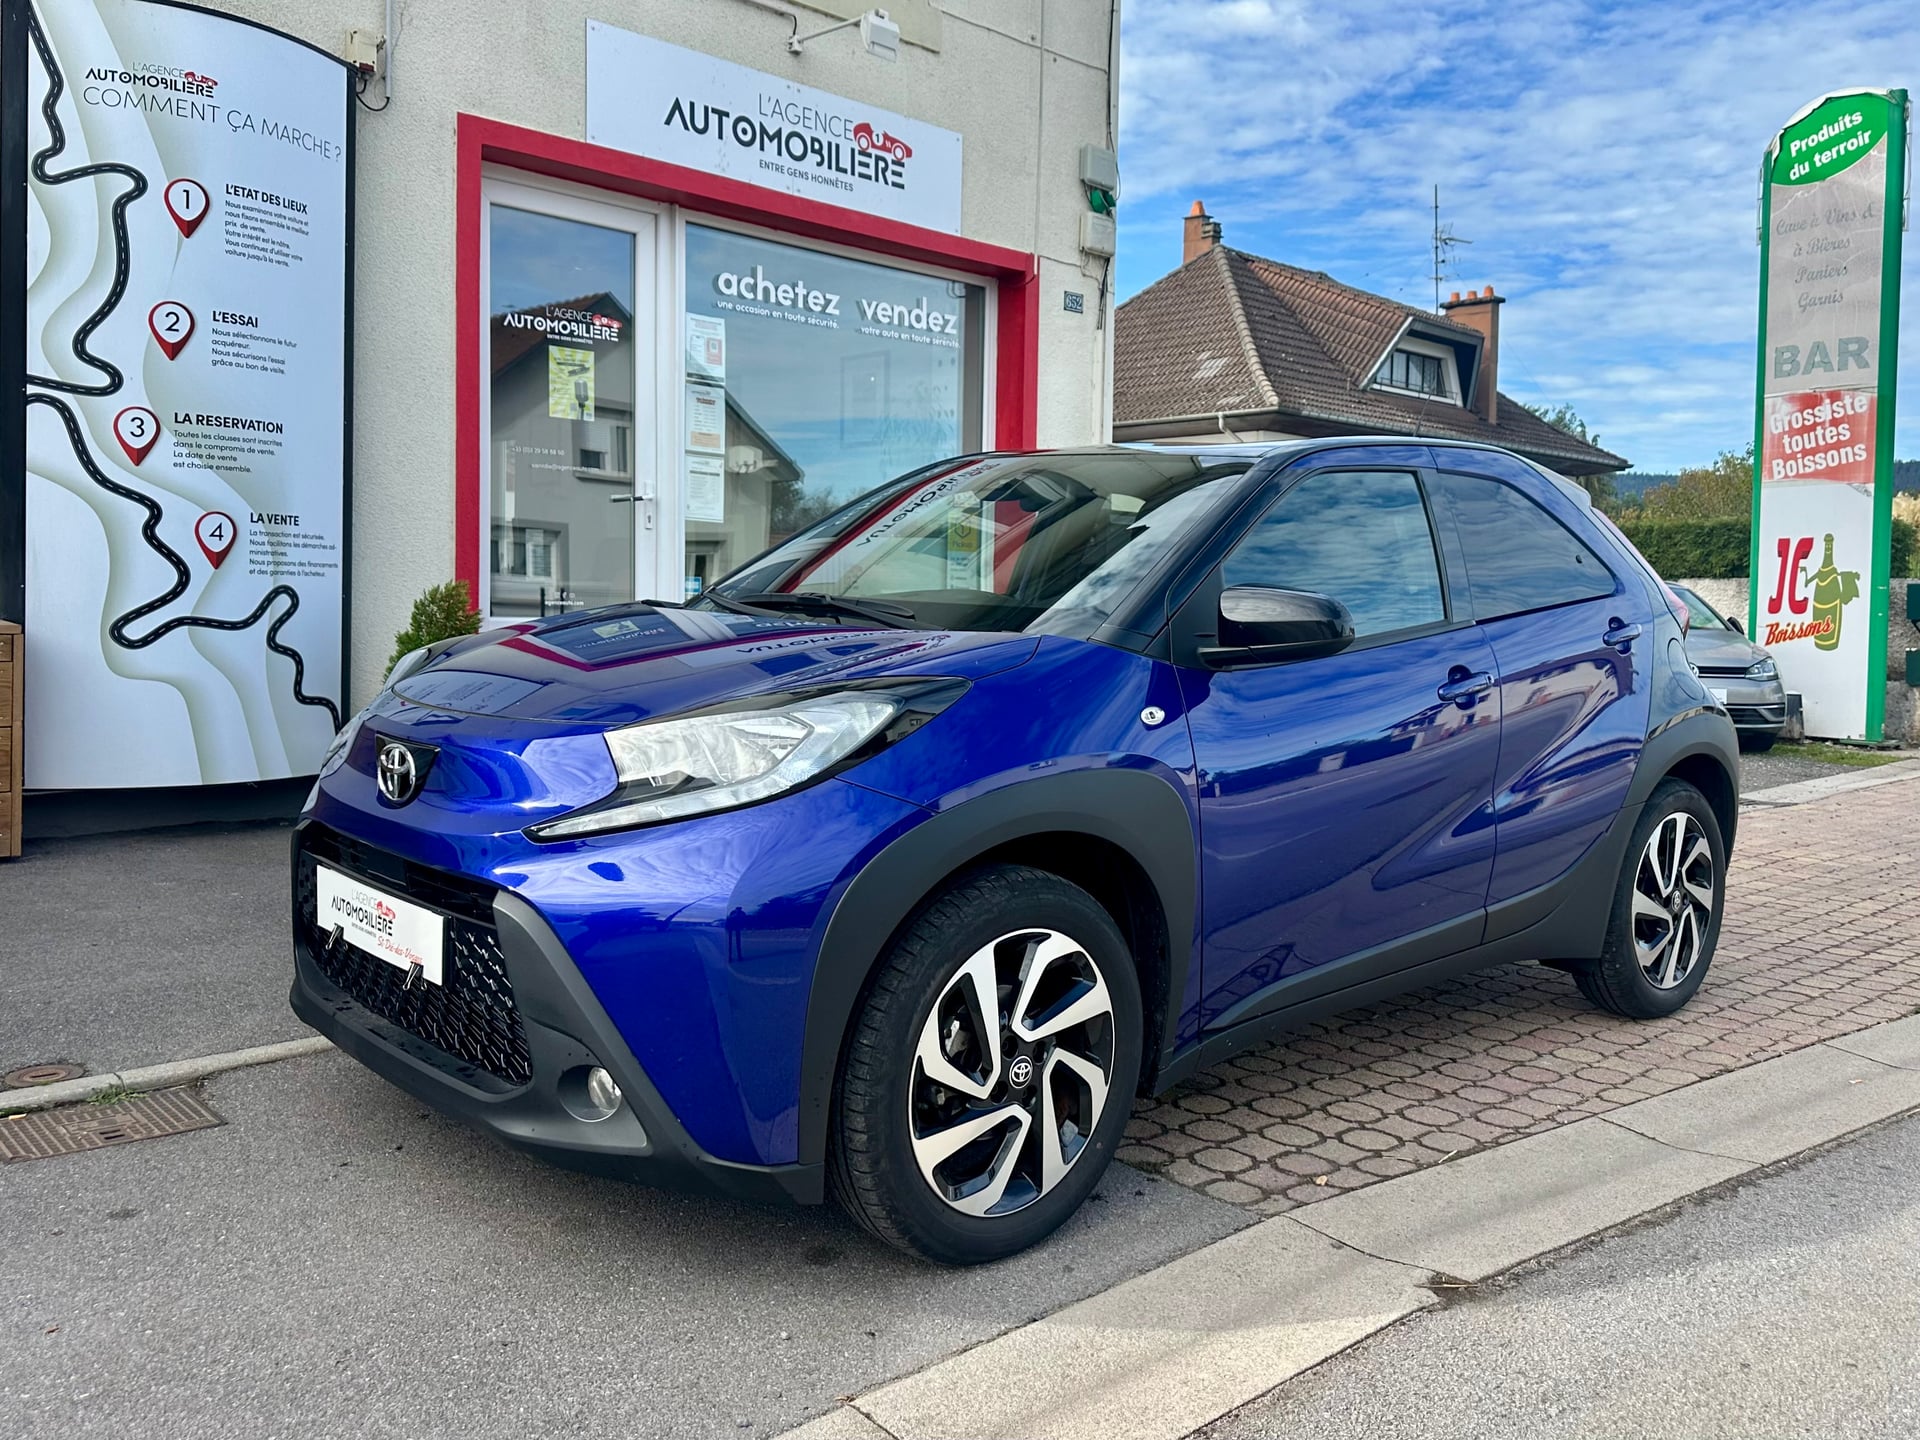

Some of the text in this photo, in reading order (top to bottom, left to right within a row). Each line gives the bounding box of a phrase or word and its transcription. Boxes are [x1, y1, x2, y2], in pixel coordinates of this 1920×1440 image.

[132, 62, 184, 78] L'AGENCE
[83, 86, 221, 123] COMMENT
[226, 110, 255, 132] ÇA
[262, 118, 331, 159] MARCHE
[759, 93, 853, 142] L'AGENCE
[1790, 112, 1863, 157] Produits
[1790, 129, 1871, 181] du terroir
[759, 159, 854, 192] ENTRE GENS HONNÊTES
[183, 190, 190, 209] 1
[225, 184, 308, 215] L'ETAT DES LIEUX
[225, 200, 241, 209] Nous
[242, 205, 273, 216] examinons
[225, 211, 240, 219] nous
[241, 213, 258, 222] fixons
[260, 219, 285, 229] ensemble
[1825, 208, 1856, 225] Vins
[225, 228, 241, 237] Votre
[225, 238, 239, 247] Vous
[241, 242, 268, 253] continuez
[225, 249, 246, 257] voiture
[718, 265, 958, 334] achetez vendez
[1066, 295, 1082, 309] 652
[212, 310, 258, 328] L'ESSAI
[546, 306, 592, 322] L'AGENCE
[717, 300, 732, 310] une
[736, 304, 770, 317] occasion
[772, 310, 782, 318] en
[785, 312, 805, 323] toute
[165, 312, 179, 332] 2
[212, 328, 230, 336] Nous
[861, 327, 880, 335] votre
[882, 330, 899, 338] auto
[912, 334, 930, 343] toute
[212, 348, 230, 356] Nous
[232, 351, 266, 362] sécurisons
[1774, 336, 1871, 379] BAR
[246, 362, 259, 370] bon
[174, 412, 283, 434] LA RESERVATION
[1770, 395, 1868, 434] Grossiste
[130, 417, 144, 438] 3
[174, 430, 199, 439] Toutes
[201, 432, 211, 440] les
[213, 433, 240, 442] clauses
[258, 439, 282, 447] inscrites
[1783, 424, 1851, 454] toutes
[174, 450, 183, 458] La
[185, 451, 204, 459] date
[204, 444, 245, 453] compromis
[187, 462, 213, 470] choisie
[1772, 443, 1867, 480] Boissons
[250, 512, 299, 526] LA VENTE
[209, 522, 224, 541] 4
[259, 530, 291, 538] transaction
[1765, 615, 1835, 646] Boissons
